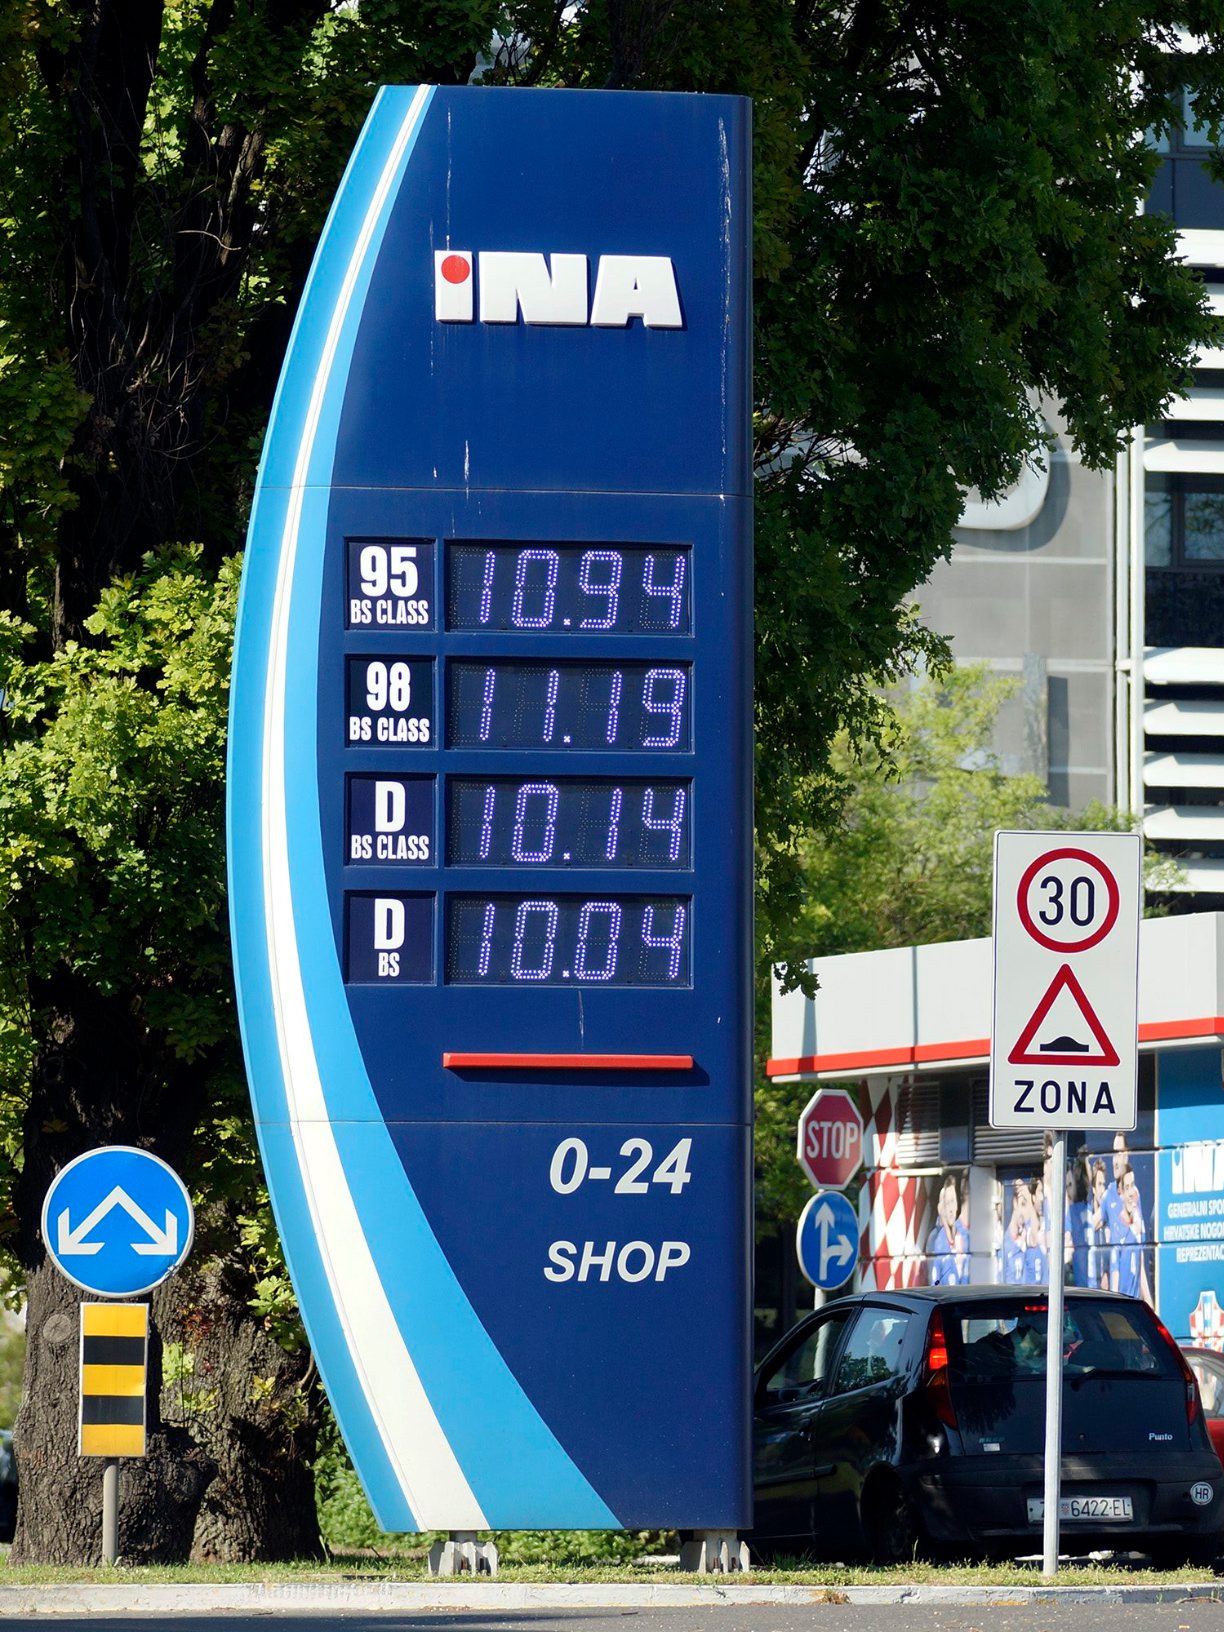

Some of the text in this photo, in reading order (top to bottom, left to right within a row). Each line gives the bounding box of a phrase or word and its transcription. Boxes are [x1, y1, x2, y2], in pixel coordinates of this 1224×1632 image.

[359, 545, 419, 597] 95
[480, 550, 686, 628] 10.94
[350, 600, 429, 625] BS CLASS
[366, 661, 411, 712] 98
[479, 669, 686, 747] 11.19
[349, 716, 430, 743] BS CLASS
[375, 781, 406, 832] D
[479, 784, 686, 862] 10.14
[351, 835, 429, 860] BS CLASS
[1039, 876, 1095, 926] 30
[374, 898, 405, 950] D
[478, 901, 686, 980] 10.04
[378, 952, 400, 977] BS
[1013, 1080, 1116, 1114] ZONA
[806, 1121, 859, 1158] STOP
[549, 1137, 693, 1194] 0-24
[1167, 1200, 1208, 1219] GENERALNI
[1163, 1223, 1200, 1241] HRVATSKE
[543, 1240, 691, 1283] SHOP
[1148, 1432, 1173, 1441] Punto
[1195, 1487, 1209, 1500] HR
